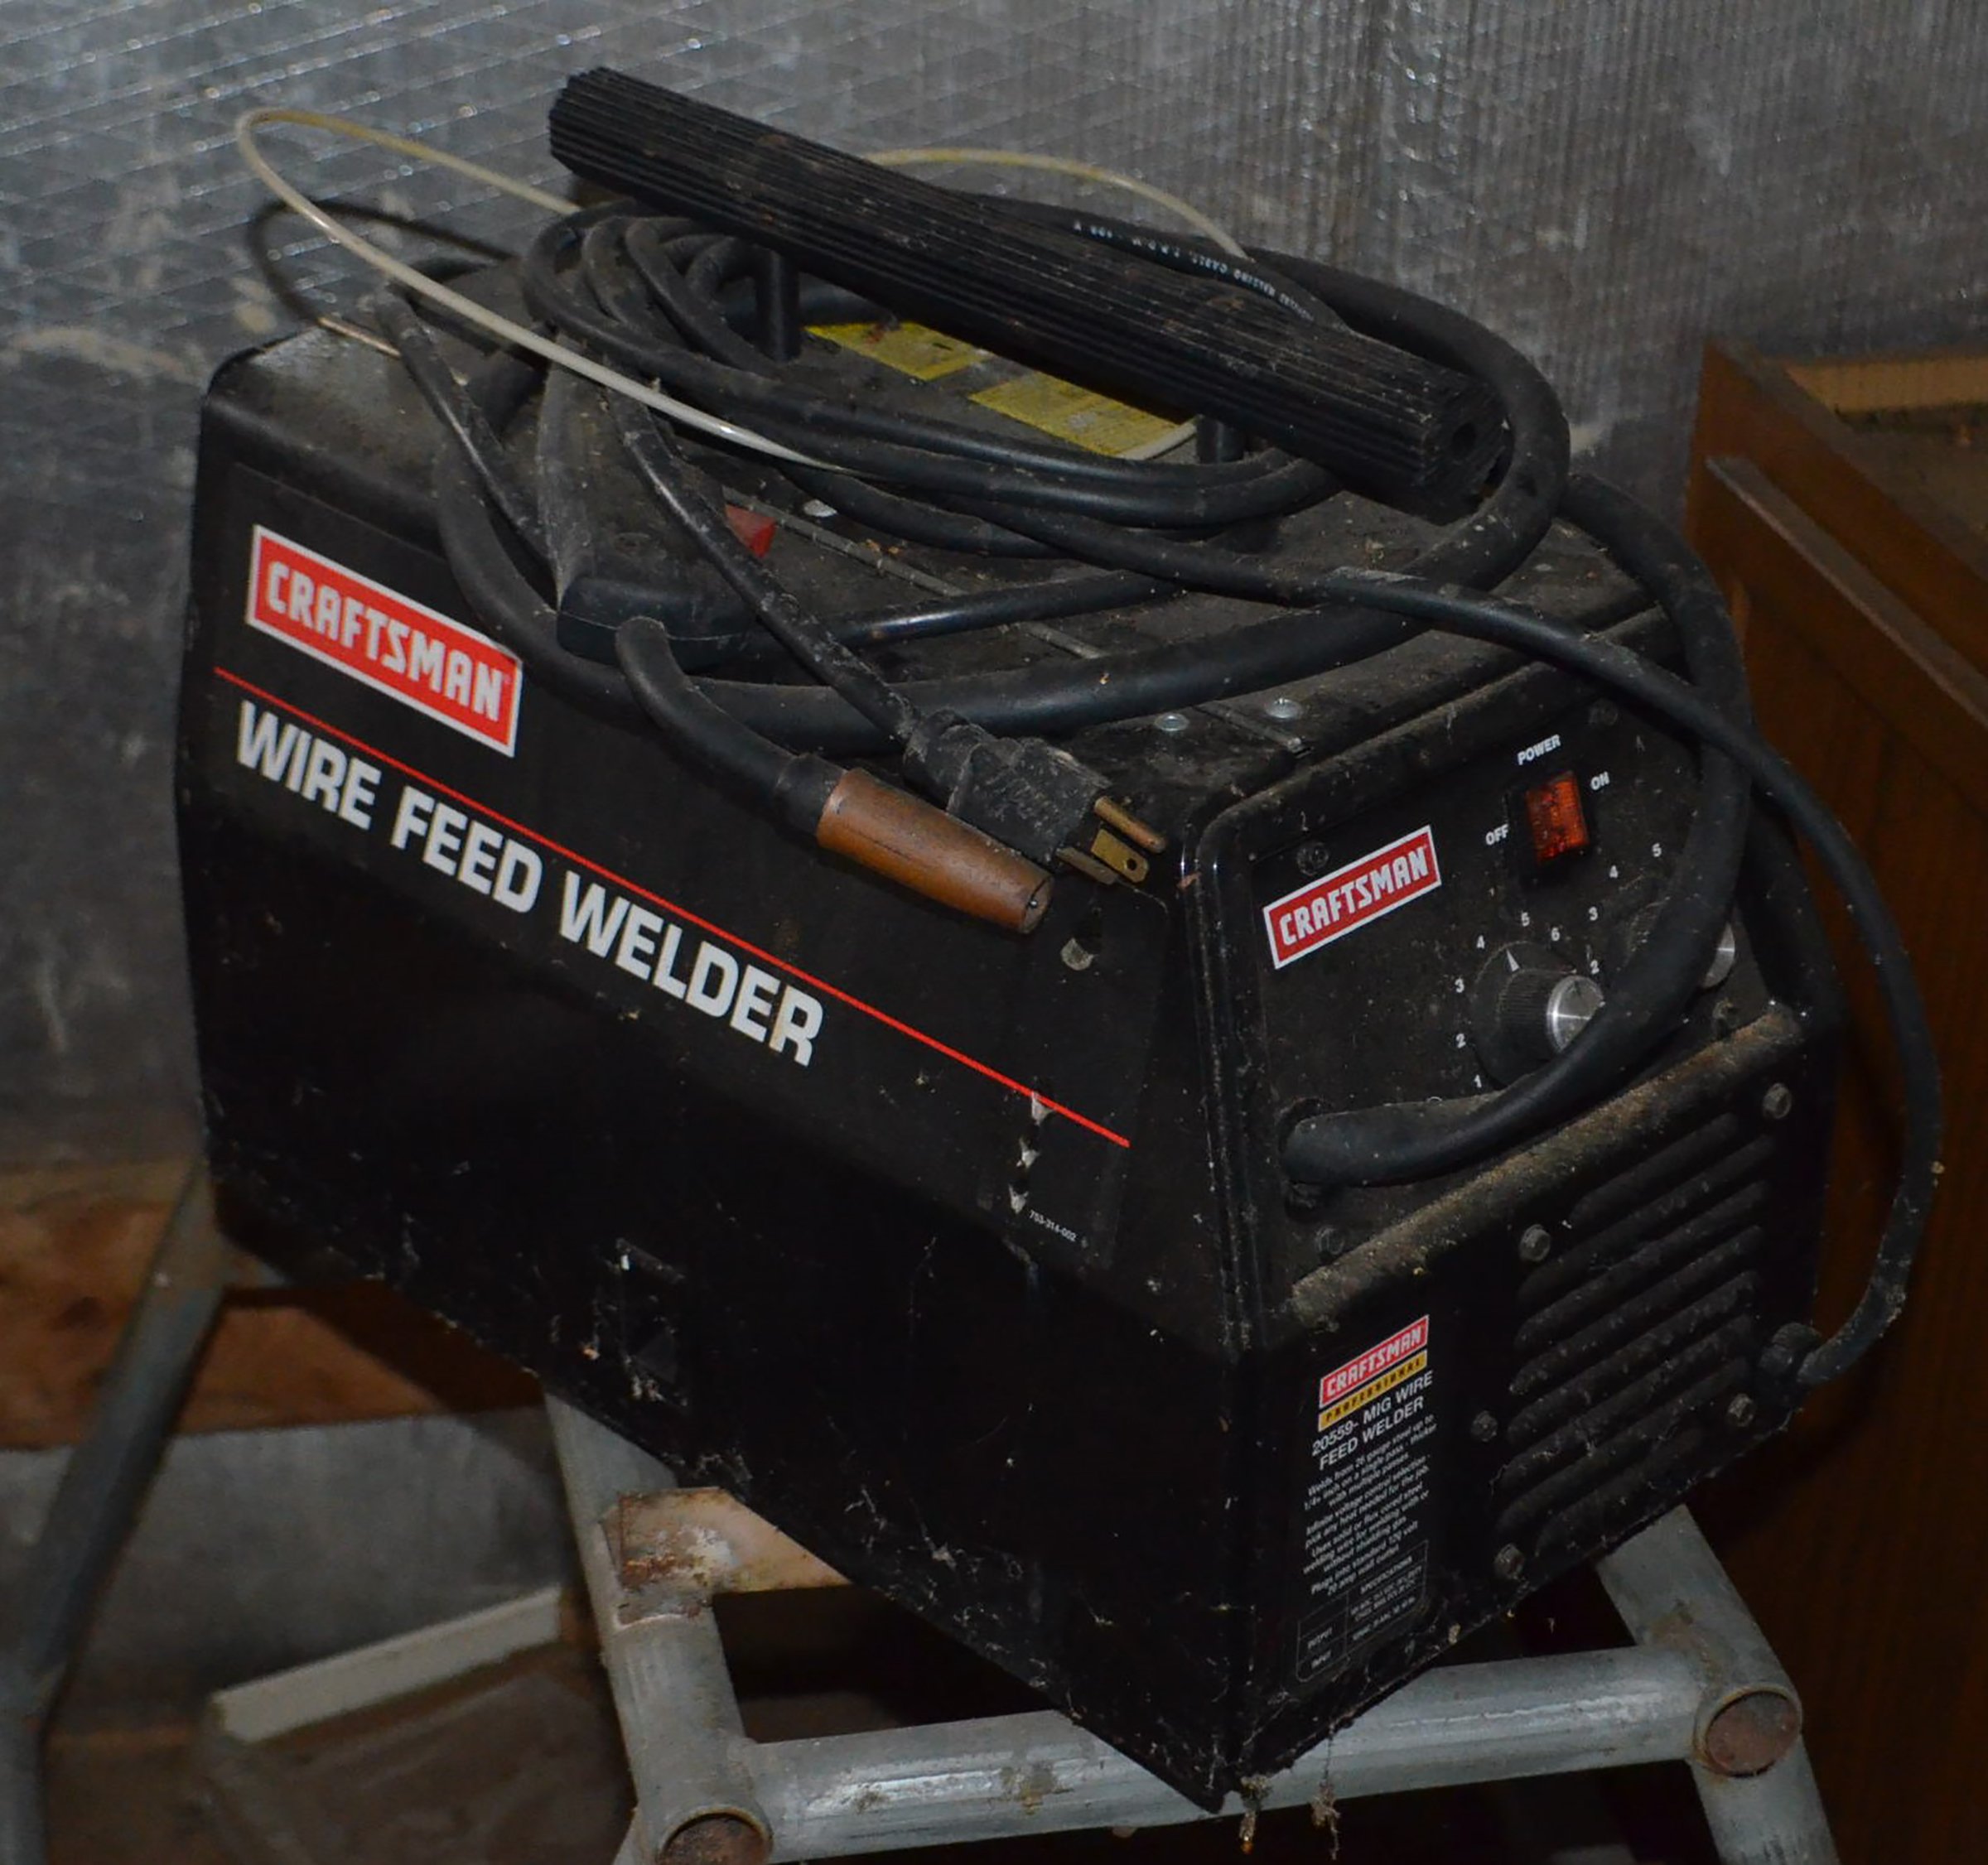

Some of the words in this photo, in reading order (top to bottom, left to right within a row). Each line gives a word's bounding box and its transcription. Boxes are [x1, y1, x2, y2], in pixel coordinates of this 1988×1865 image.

[265, 560, 502, 722] CRAFTSMAN
[1517, 735, 1560, 766] POWER
[1590, 771, 1609, 790] ON
[1487, 824, 1509, 846] OFF
[1652, 843, 1662, 857] 5
[1609, 865, 1619, 879] 4
[237, 700, 382, 831] WIRE
[390, 786, 542, 913] FEED
[558, 870, 824, 1067] WELDER
[1280, 844, 1429, 947] CRAFTSMAN
[1521, 912, 1530, 927] 5
[1589, 907, 1599, 921] 3
[1475, 935, 1485, 950] 4
[1551, 928, 1560, 942] 6
[1590, 960, 1600, 975] 2
[1455, 978, 1464, 993] 3
[1456, 1034, 1466, 1048] 2
[1474, 1074, 1483, 1088] 1
[1327, 1326, 1421, 1396] CRAFTSMAN
[1363, 1397, 1392, 1424] MIG
[1396, 1370, 1434, 1403] WIRE
[1320, 1437, 1358, 1471] FEED
[1362, 1395, 1424, 1443] WELDER
